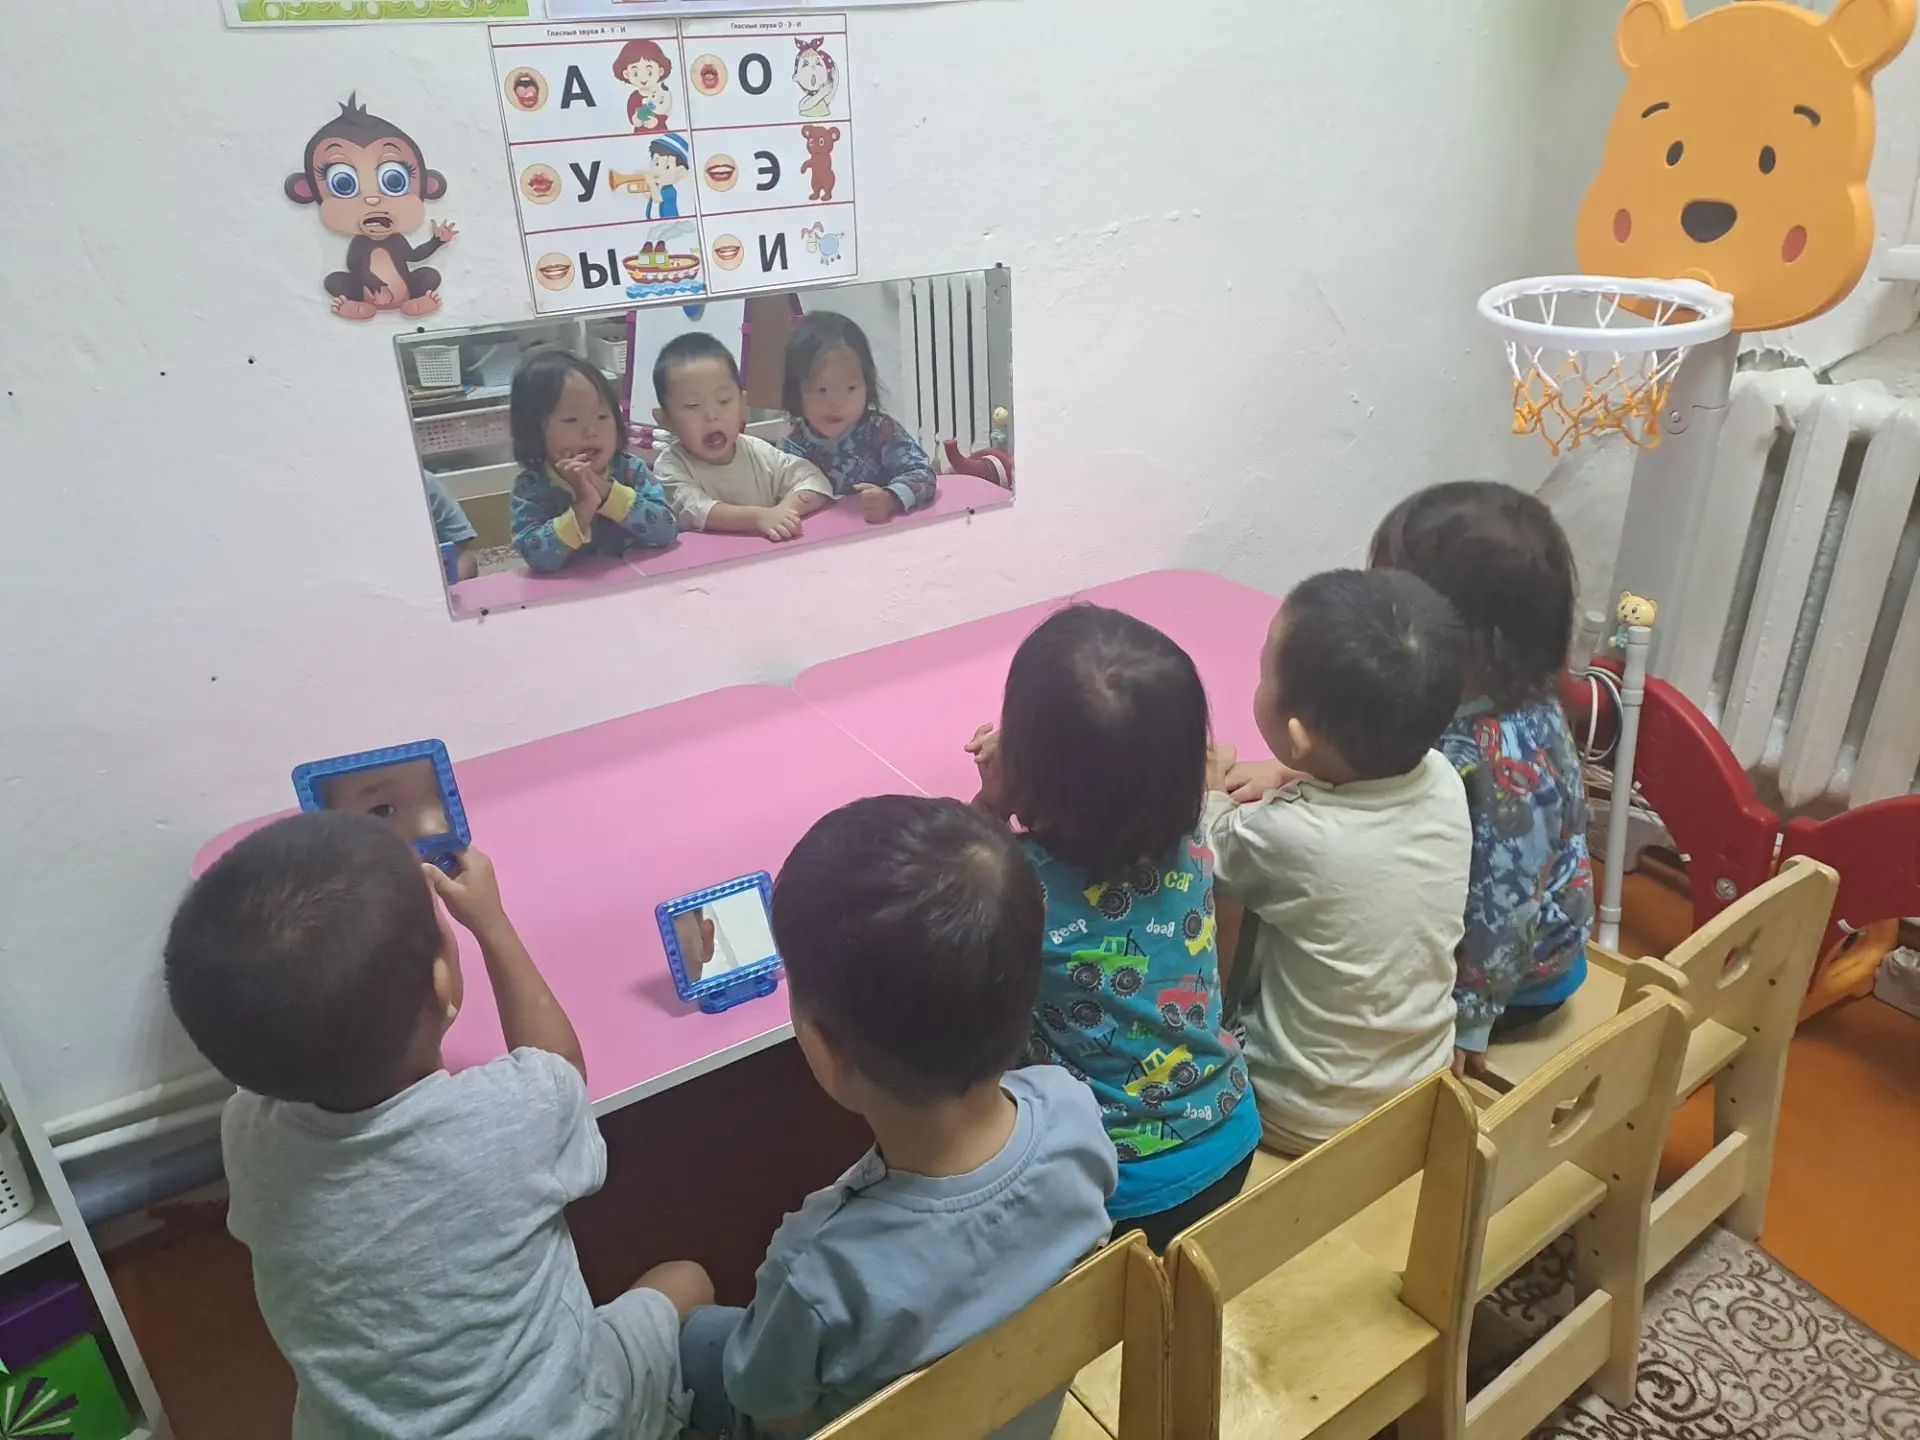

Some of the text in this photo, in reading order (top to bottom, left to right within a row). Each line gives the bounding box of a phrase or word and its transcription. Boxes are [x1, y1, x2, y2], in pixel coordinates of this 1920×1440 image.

[561, 65, 597, 109] А
[738, 53, 772, 95] О
[569, 160, 602, 203] У
[754, 150, 781, 191] Э
[578, 248, 621, 289] Ы
[759, 232, 789, 273] И
[1048, 918, 1088, 945] Beep
[1145, 917, 1176, 938] Beep
[1183, 1101, 1213, 1121] Beep
